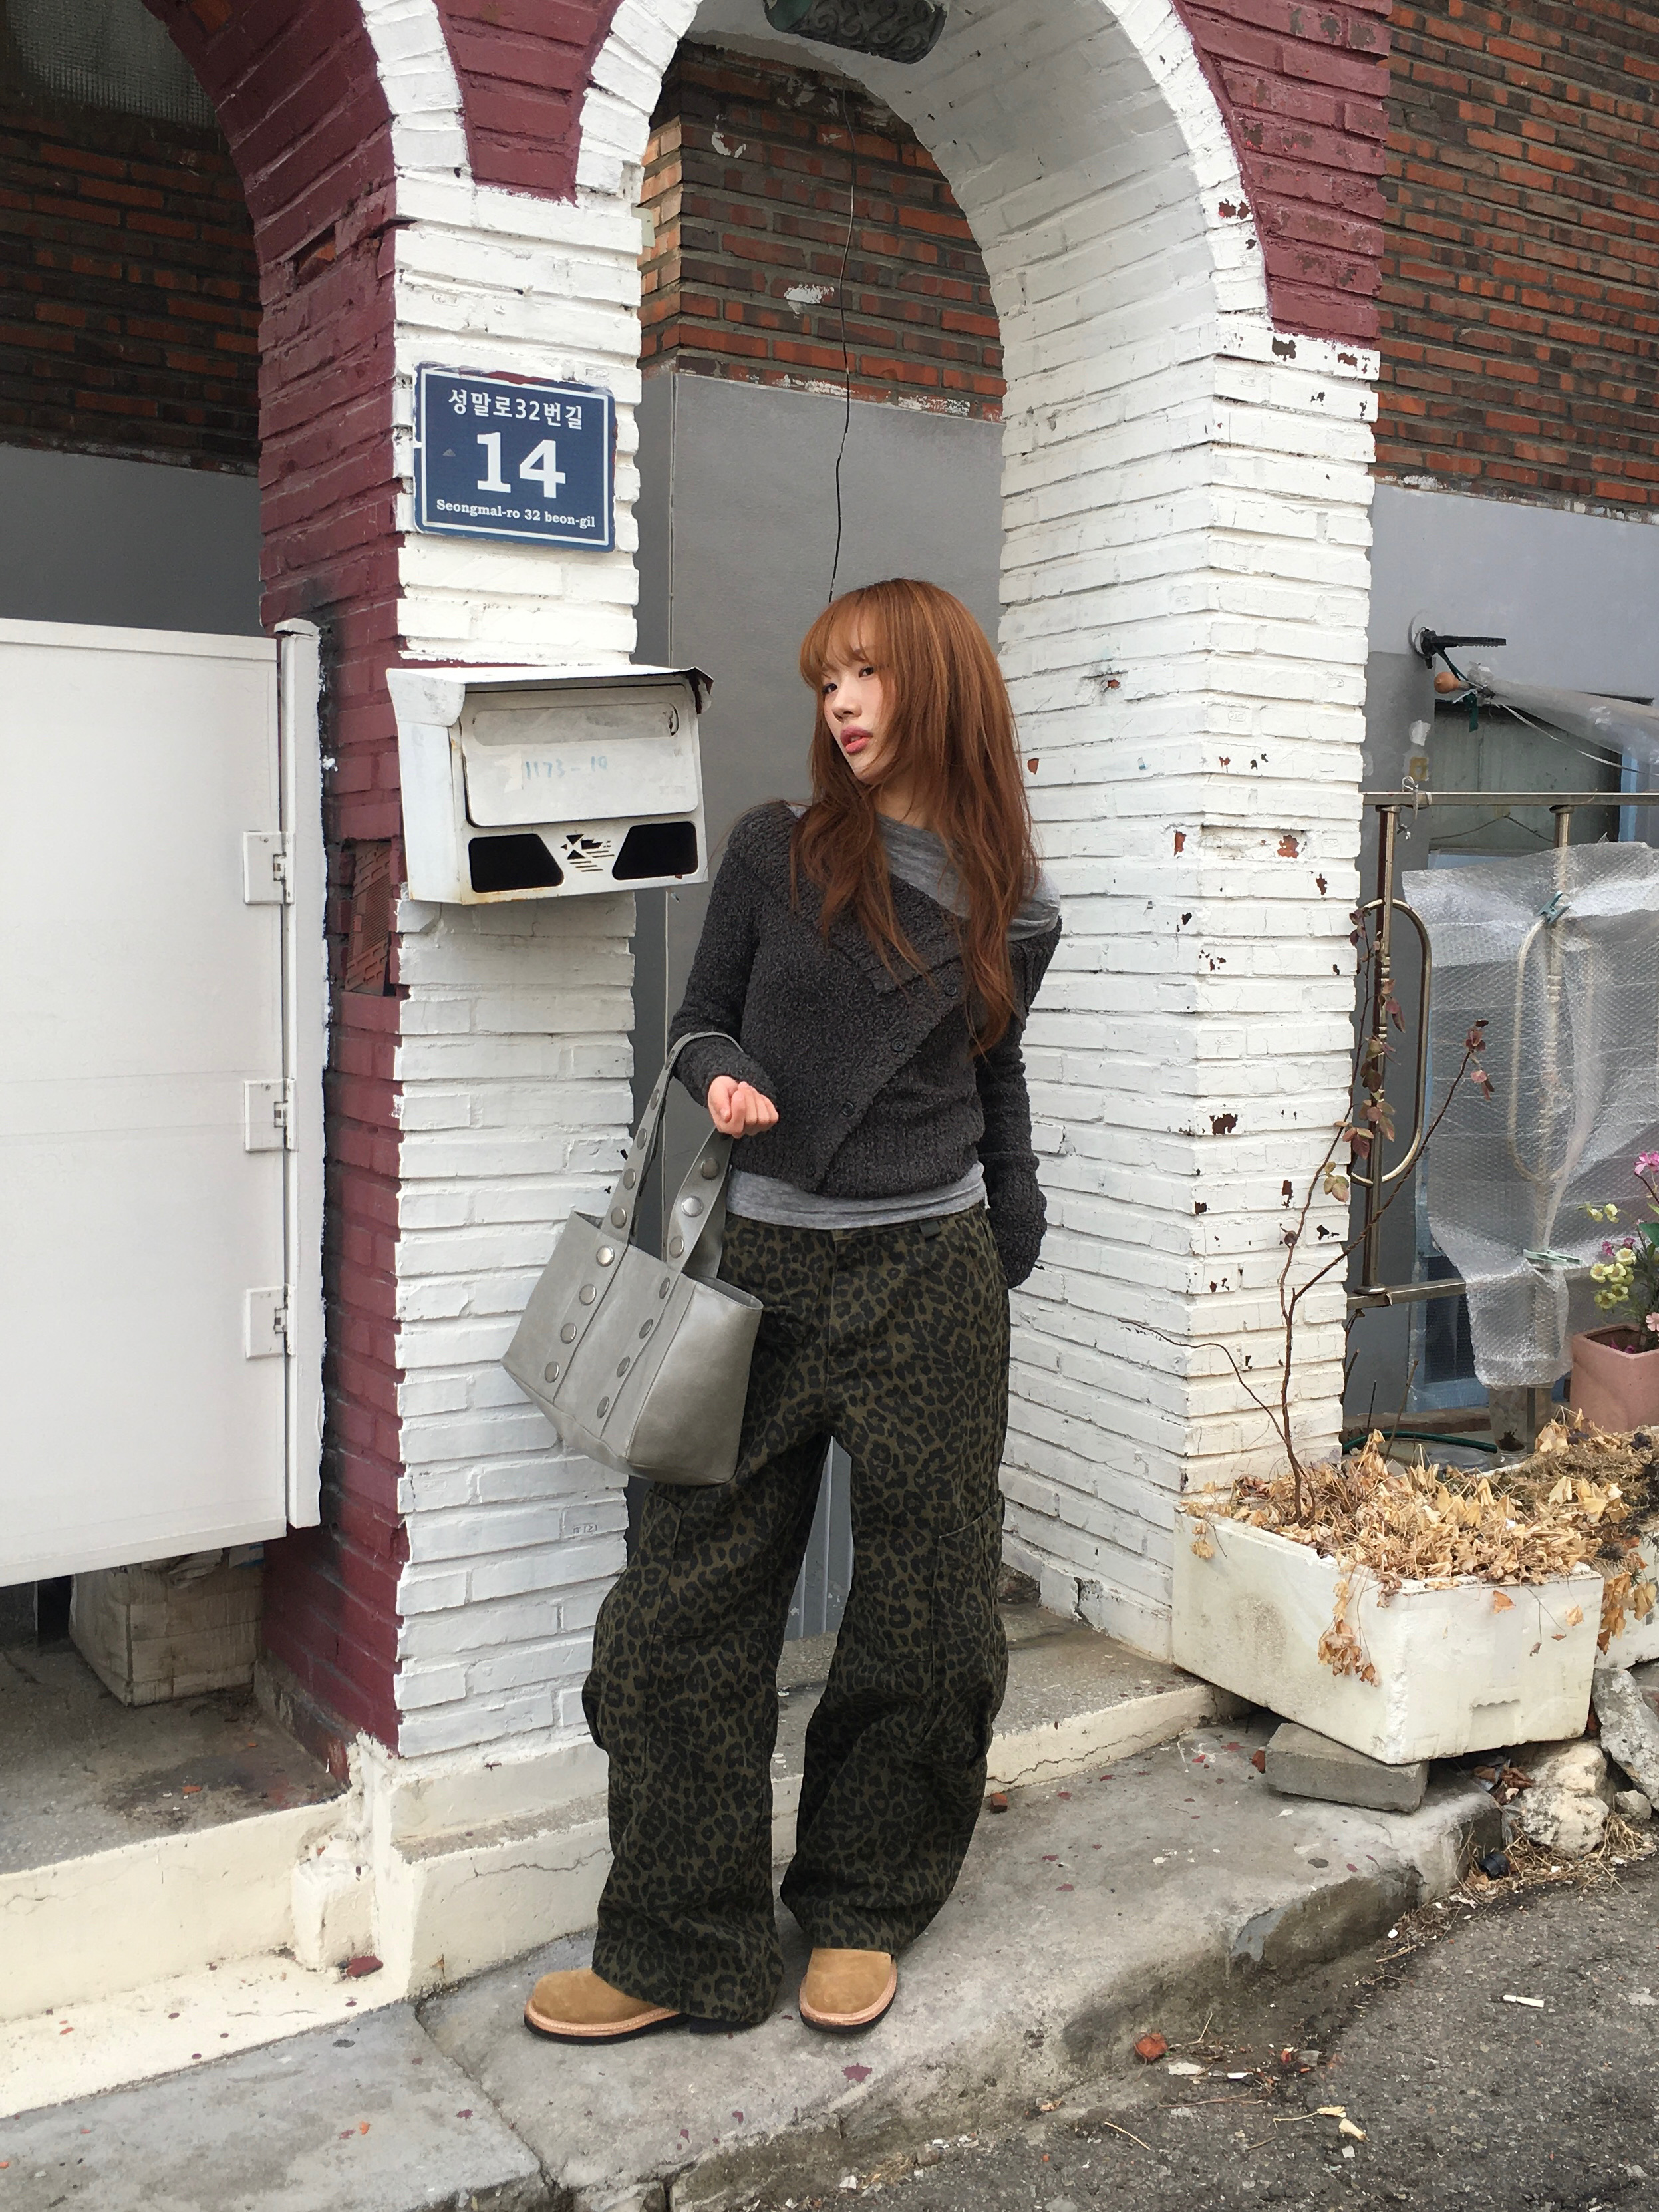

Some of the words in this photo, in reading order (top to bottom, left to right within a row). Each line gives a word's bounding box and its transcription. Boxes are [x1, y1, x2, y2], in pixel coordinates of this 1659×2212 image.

[448, 389, 583, 430] 성말로32번길
[476, 432, 566, 499] 14
[436, 499, 521, 518] Seongmal-ro
[524, 510, 541, 522] 32
[545, 511, 596, 530] beon-gil
